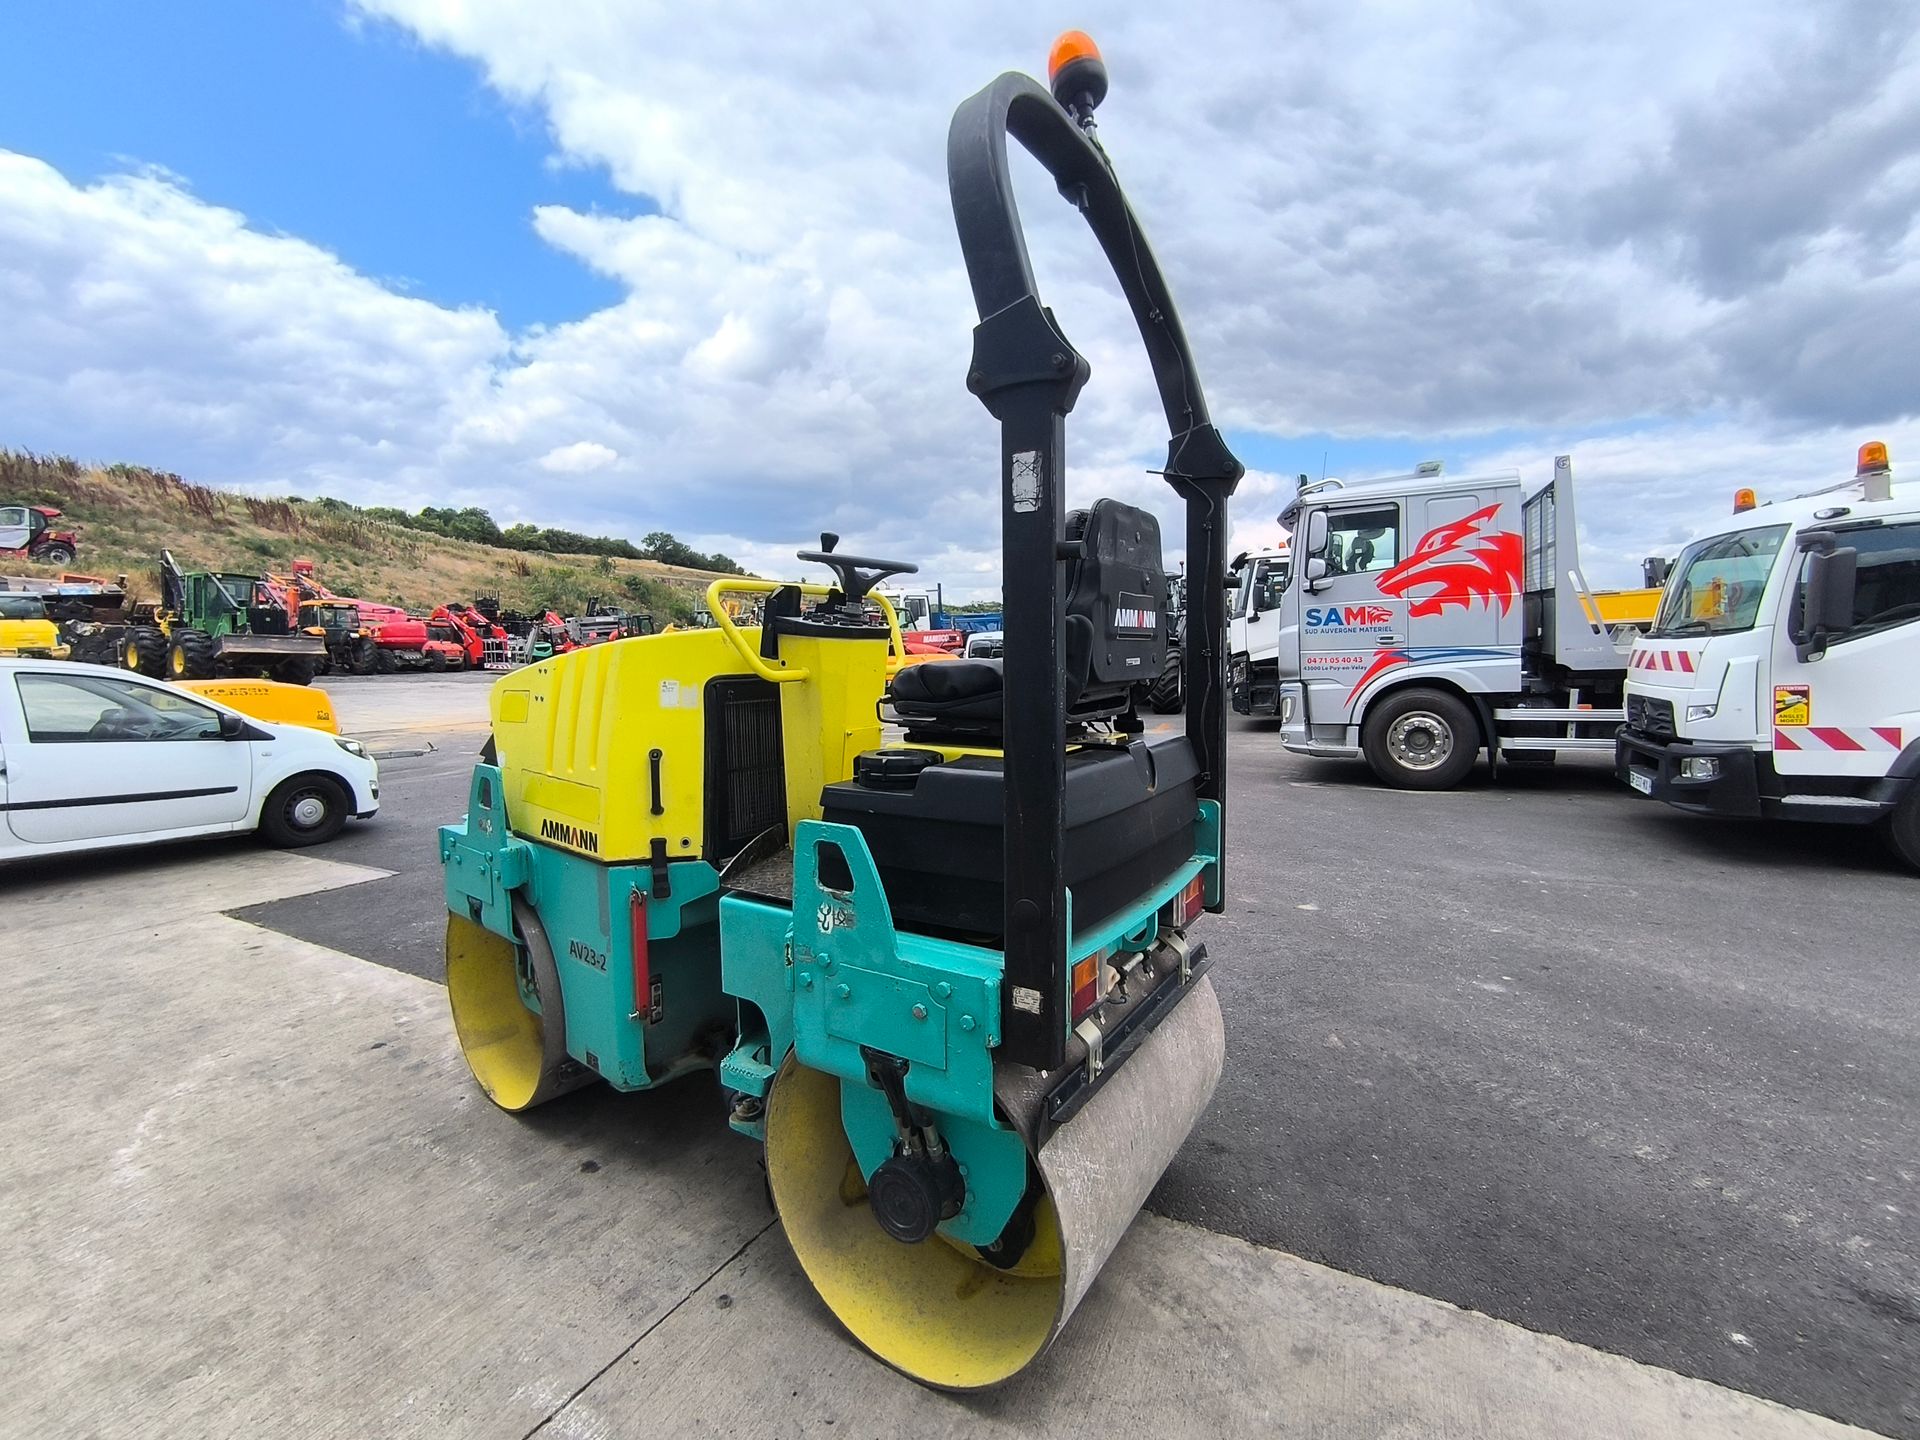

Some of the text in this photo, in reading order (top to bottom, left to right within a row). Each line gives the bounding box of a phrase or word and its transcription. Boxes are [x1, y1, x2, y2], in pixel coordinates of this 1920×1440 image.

[1114, 608, 1156, 628] AMMANN
[1306, 607, 1366, 626] SAM
[541, 818, 598, 853] AMMANN
[569, 940, 607, 971] AV23-2
